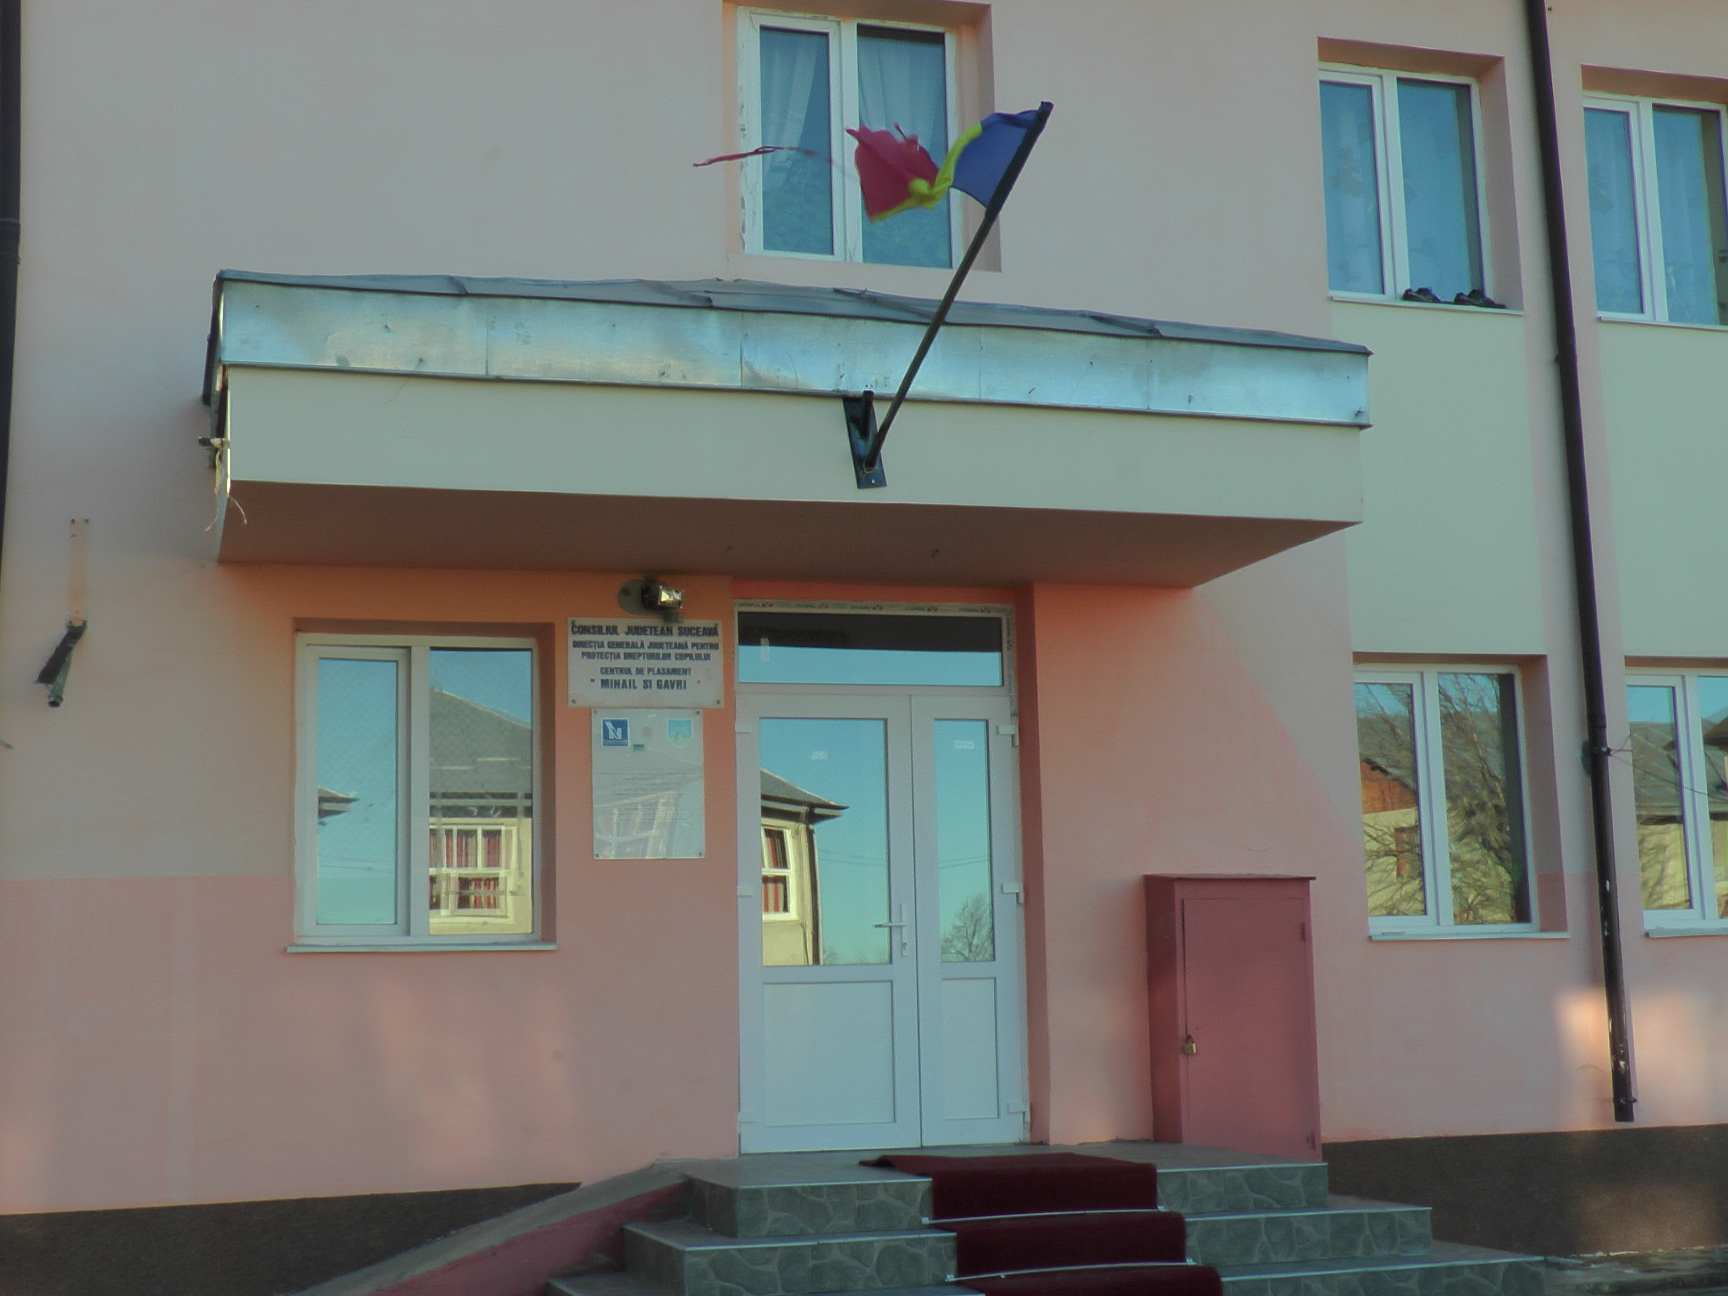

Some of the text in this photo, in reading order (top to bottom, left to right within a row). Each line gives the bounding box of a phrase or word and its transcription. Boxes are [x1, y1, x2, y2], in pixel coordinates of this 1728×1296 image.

[571, 624, 620, 635] CONSILIUL
[691, 641, 719, 650] PENTRU
[674, 652, 711, 661] COPILULUI
[600, 667, 691, 676] CENTRUL DE PLASAMENT
